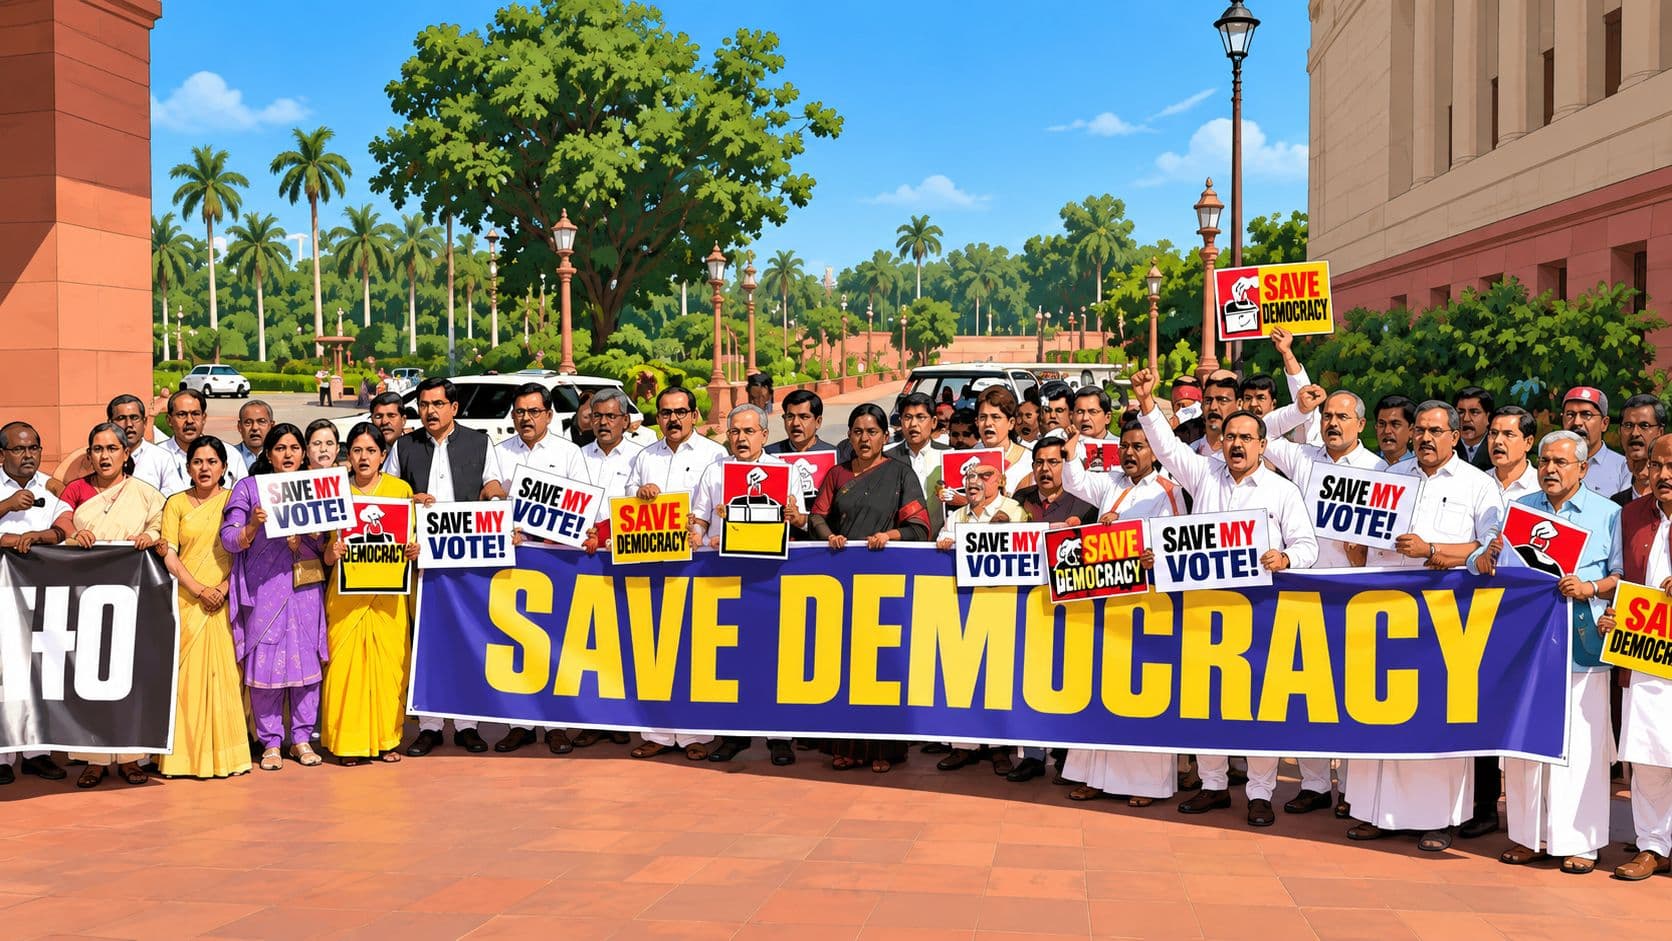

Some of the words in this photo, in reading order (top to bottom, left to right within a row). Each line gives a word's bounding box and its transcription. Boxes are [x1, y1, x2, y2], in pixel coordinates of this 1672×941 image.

[1264, 271, 1320, 300] SAVE
[1262, 298, 1328, 324] DEMOCRACY
[267, 479, 313, 504] SAVE
[313, 475, 341, 499] MY
[518, 477, 563, 507] SAVE
[561, 488, 593, 514] MY
[1319, 475, 1371, 506] SAVE
[1371, 482, 1405, 510] MY
[272, 498, 348, 529] VOTE!
[426, 511, 472, 534] SAVE
[475, 511, 504, 533] MY
[513, 498, 586, 539] VOTE!
[619, 501, 681, 533] SAVE
[1316, 501, 1397, 540] VOTE!
[428, 535, 506, 560] VOTE!
[616, 530, 687, 554] DEMOCRACY
[966, 532, 1009, 553] SAVE
[1012, 531, 1040, 552] MY
[1084, 529, 1139, 563] SAVE
[1162, 523, 1217, 552] SAVE
[1219, 519, 1256, 548] MY
[344, 544, 406, 563] DEMOCRACY
[967, 554, 1040, 577] VOTE!
[1165, 548, 1259, 582] VOTE!
[1055, 560, 1141, 595] DEMOCRACY
[1625, 597, 1672, 640] SA
[485, 569, 742, 703] SAVE
[777, 573, 1506, 726] DEMOCRACY
